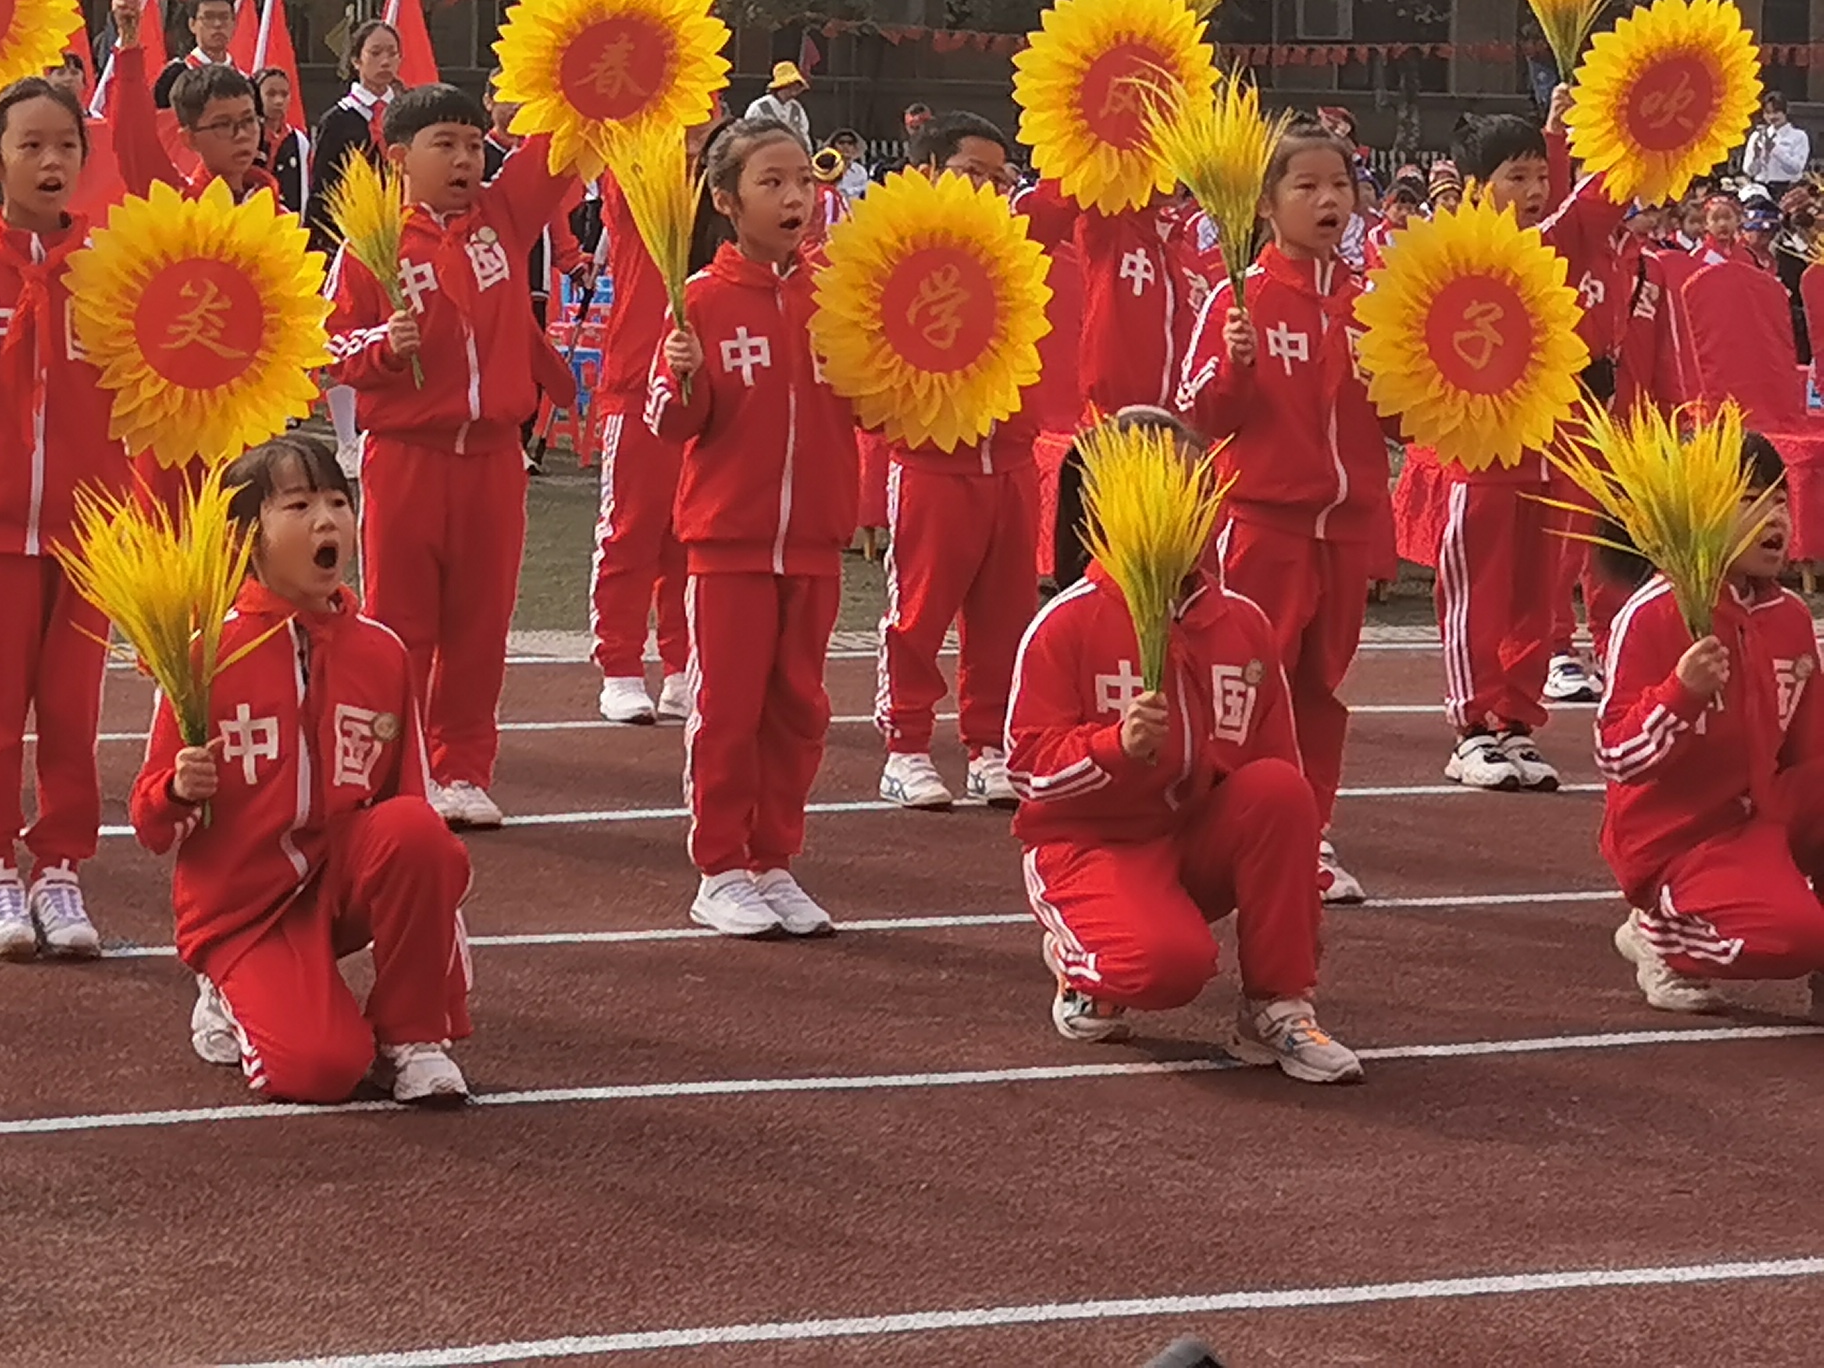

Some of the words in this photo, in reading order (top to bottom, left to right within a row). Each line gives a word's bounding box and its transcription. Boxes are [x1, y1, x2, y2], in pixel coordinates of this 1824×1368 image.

[575, 32, 649, 100] 春
[906, 262, 969, 350] 学
[1452, 299, 1506, 370] 子
[219, 703, 383, 790] 中国
